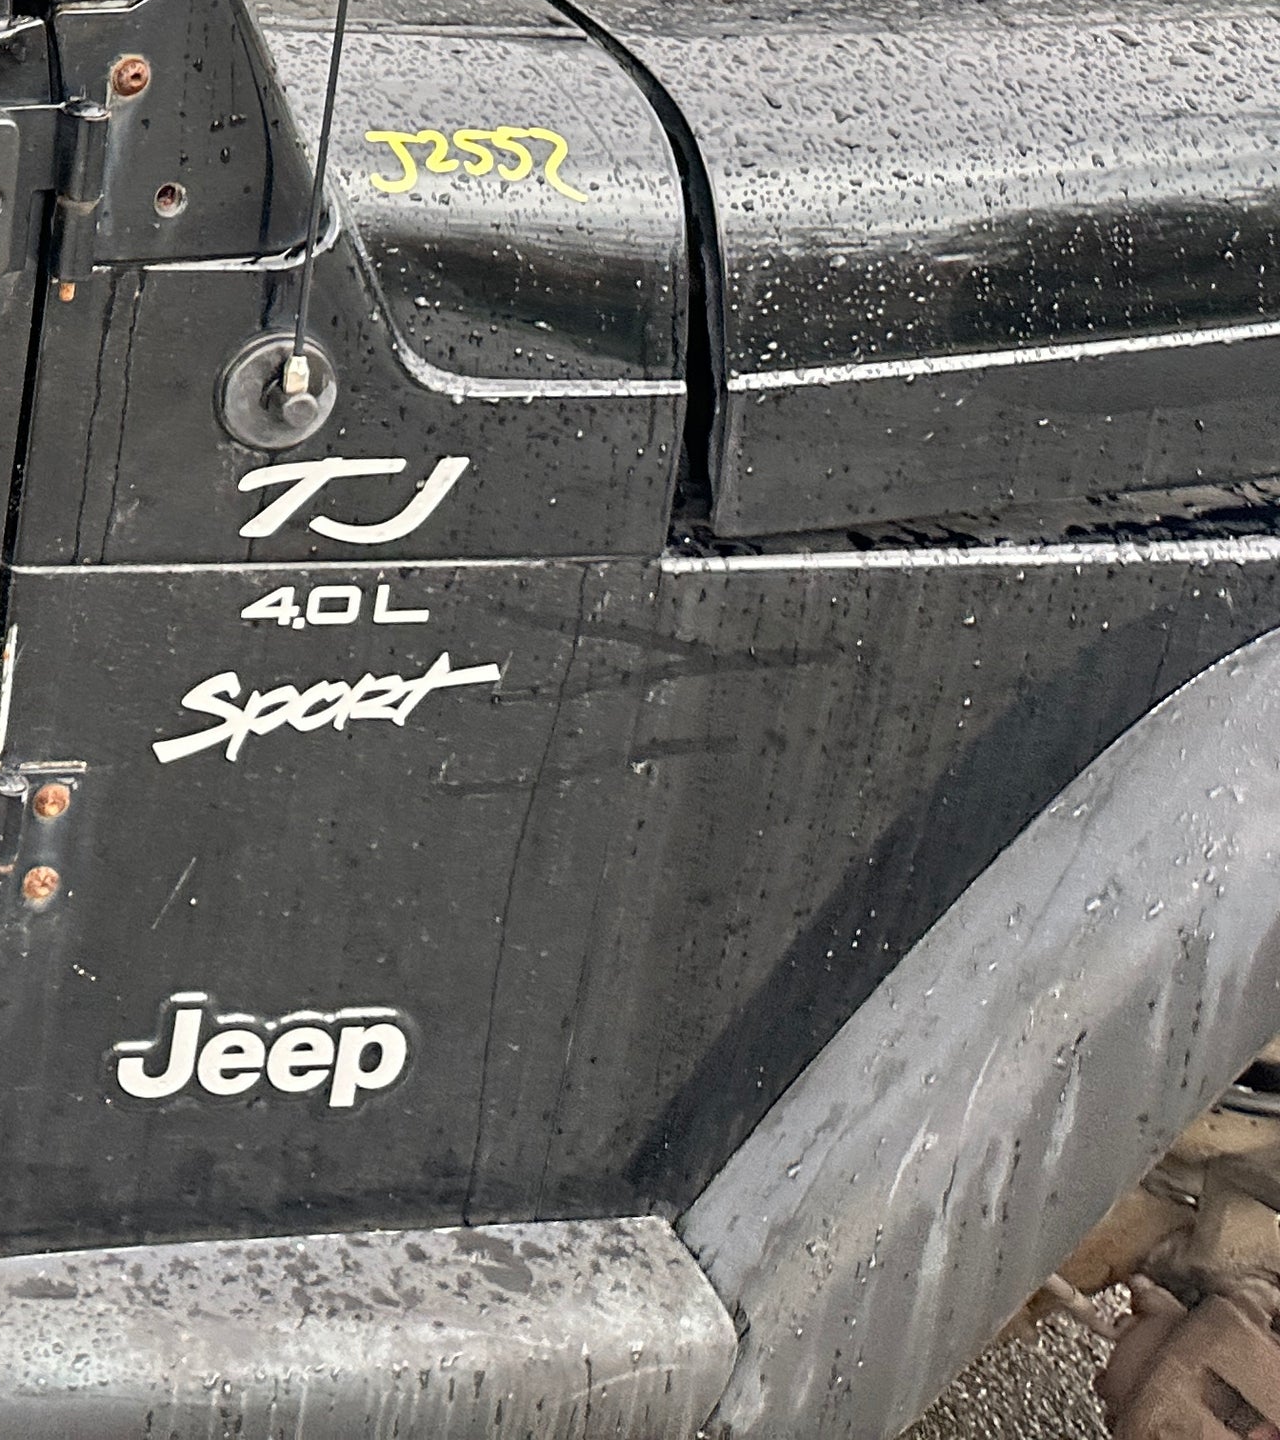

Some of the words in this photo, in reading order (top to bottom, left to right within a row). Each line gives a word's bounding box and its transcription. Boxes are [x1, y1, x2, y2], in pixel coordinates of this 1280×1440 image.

[364, 126, 589, 203] J2552
[237, 456, 471, 544] TJ
[151, 651, 502, 764] Sport
[112, 992, 408, 1108] Jeep
